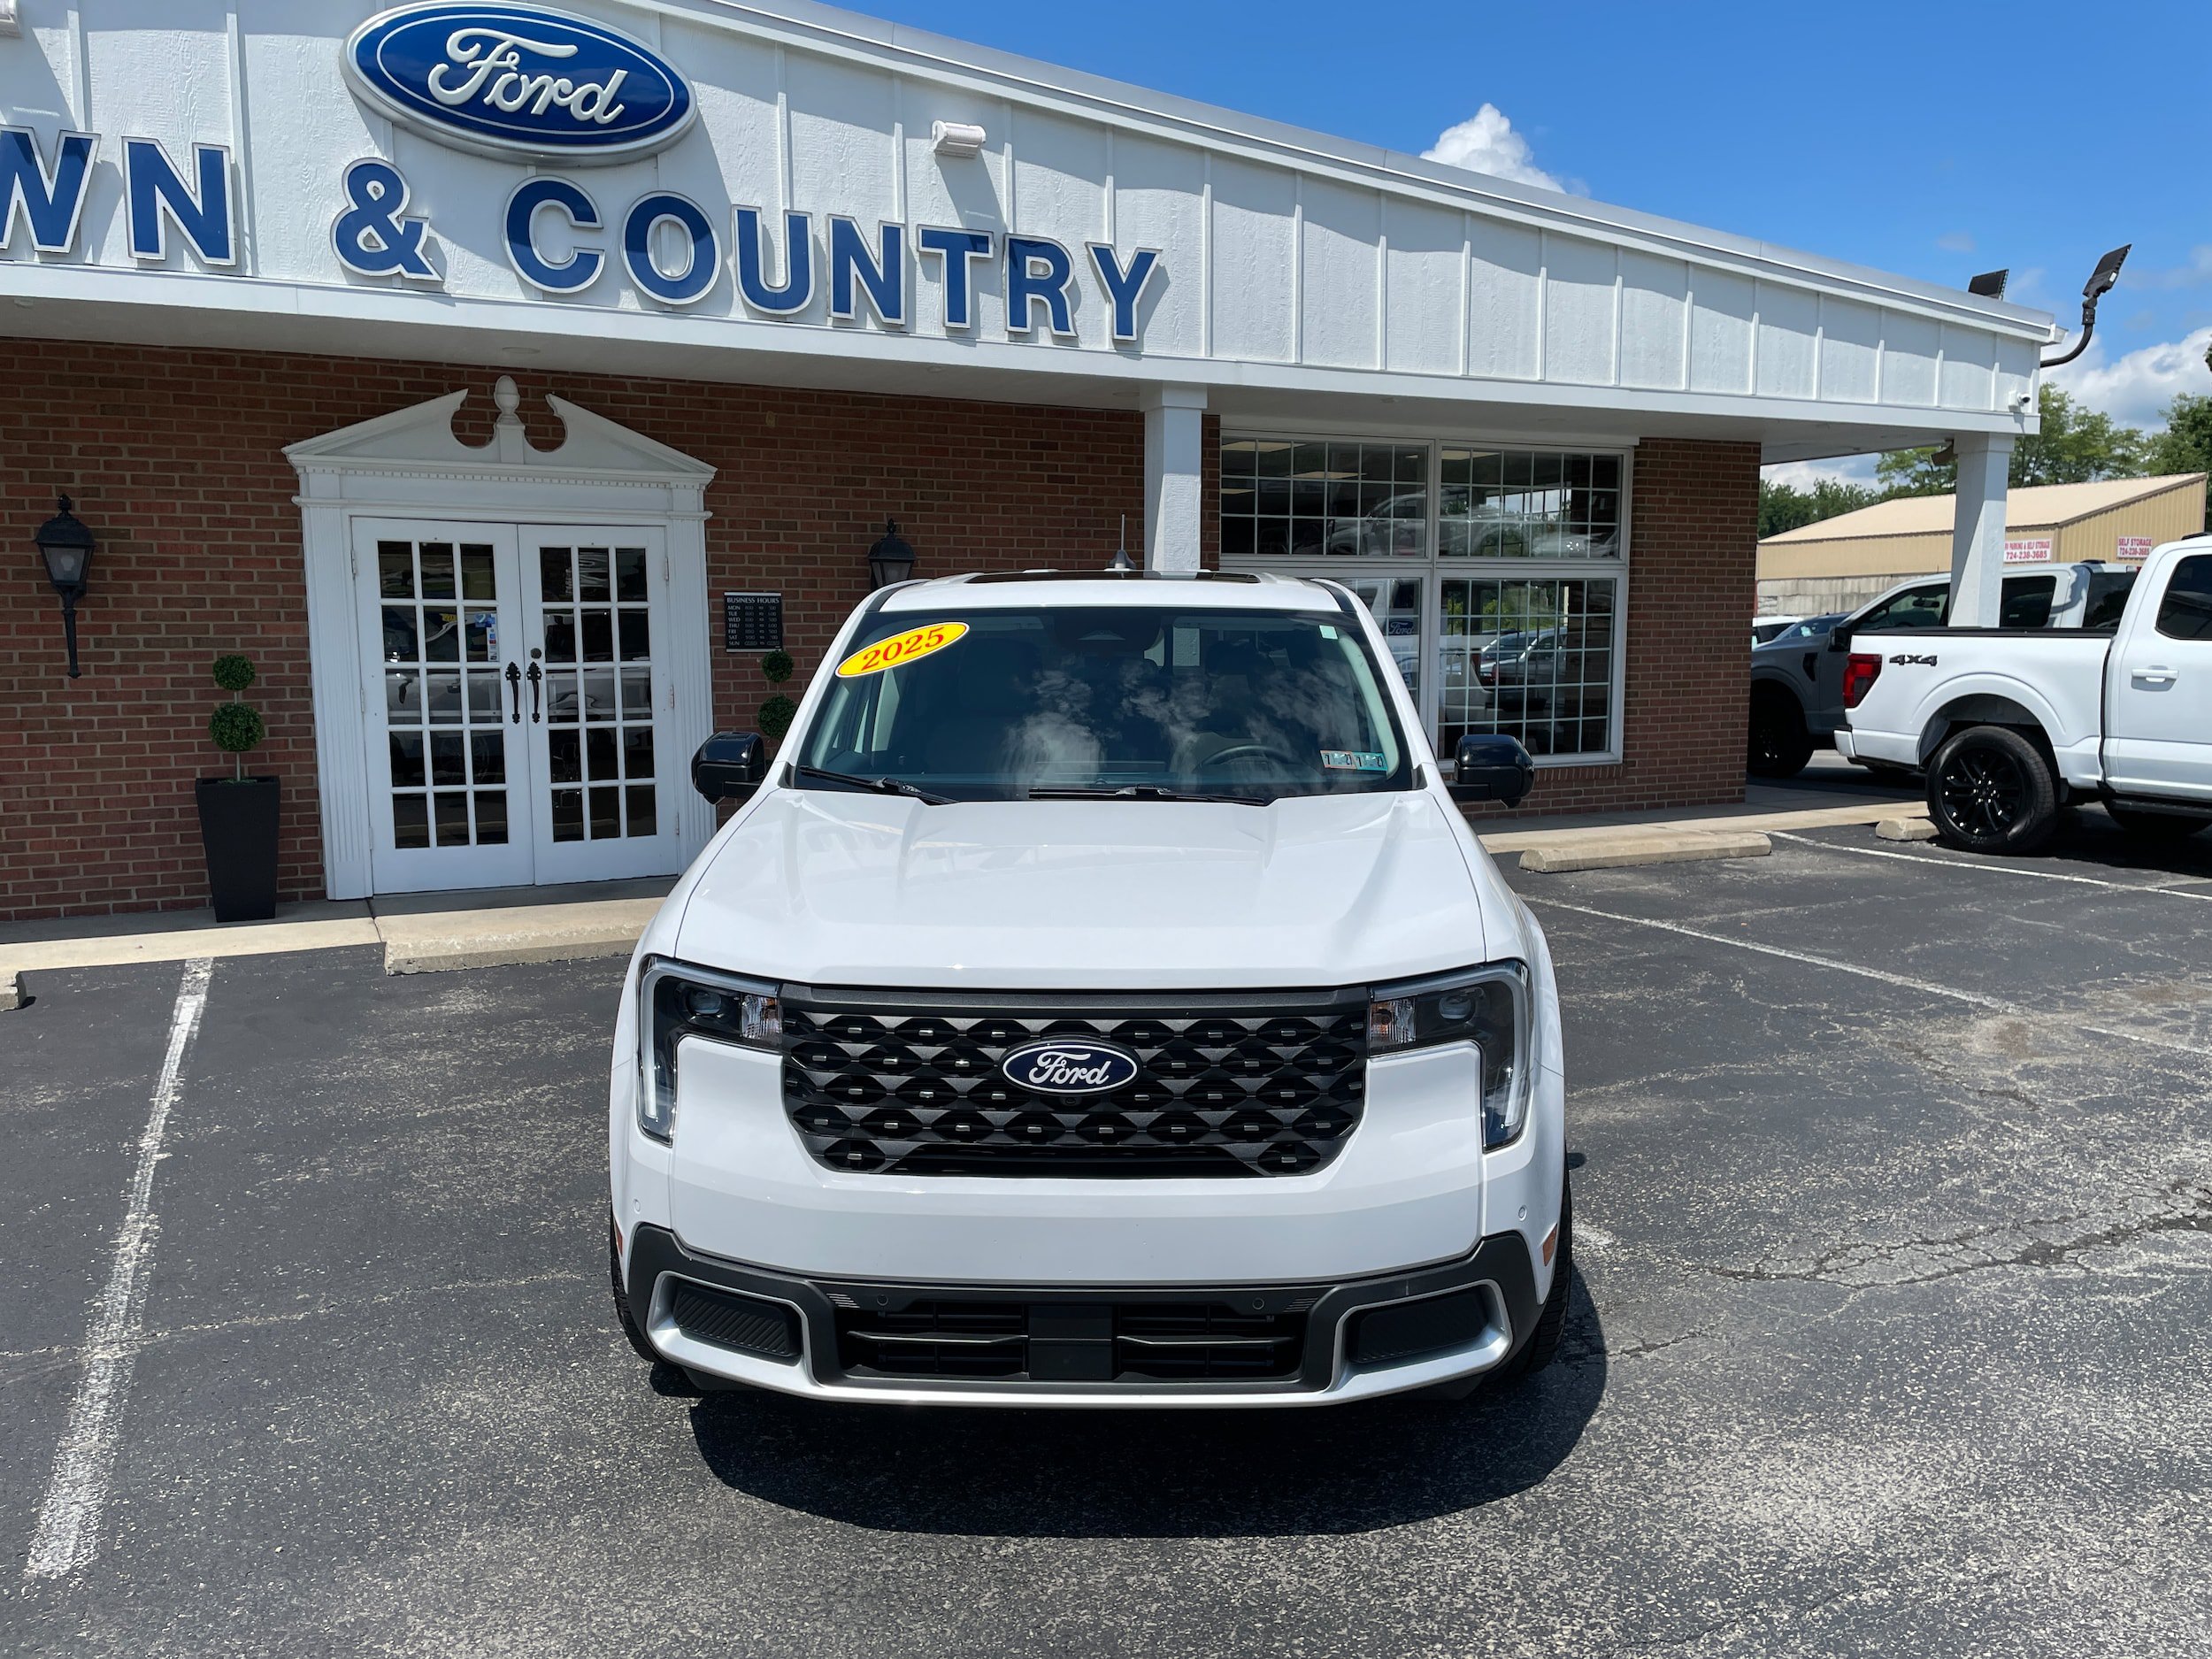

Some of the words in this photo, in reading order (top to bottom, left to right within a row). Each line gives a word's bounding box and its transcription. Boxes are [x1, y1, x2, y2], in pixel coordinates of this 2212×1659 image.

[428, 27, 628, 125] Ford
[330, 157, 444, 281] &
[502, 175, 1163, 342] COUNTRY
[2006, 550, 2047, 560] 724-238-3685
[2118, 538, 2130, 547] SELF
[2131, 538, 2152, 547] STORAGE
[1388, 621, 1415, 635] Ford
[861, 626, 945, 672] 2025
[1028, 1051, 1112, 1085] Ford
